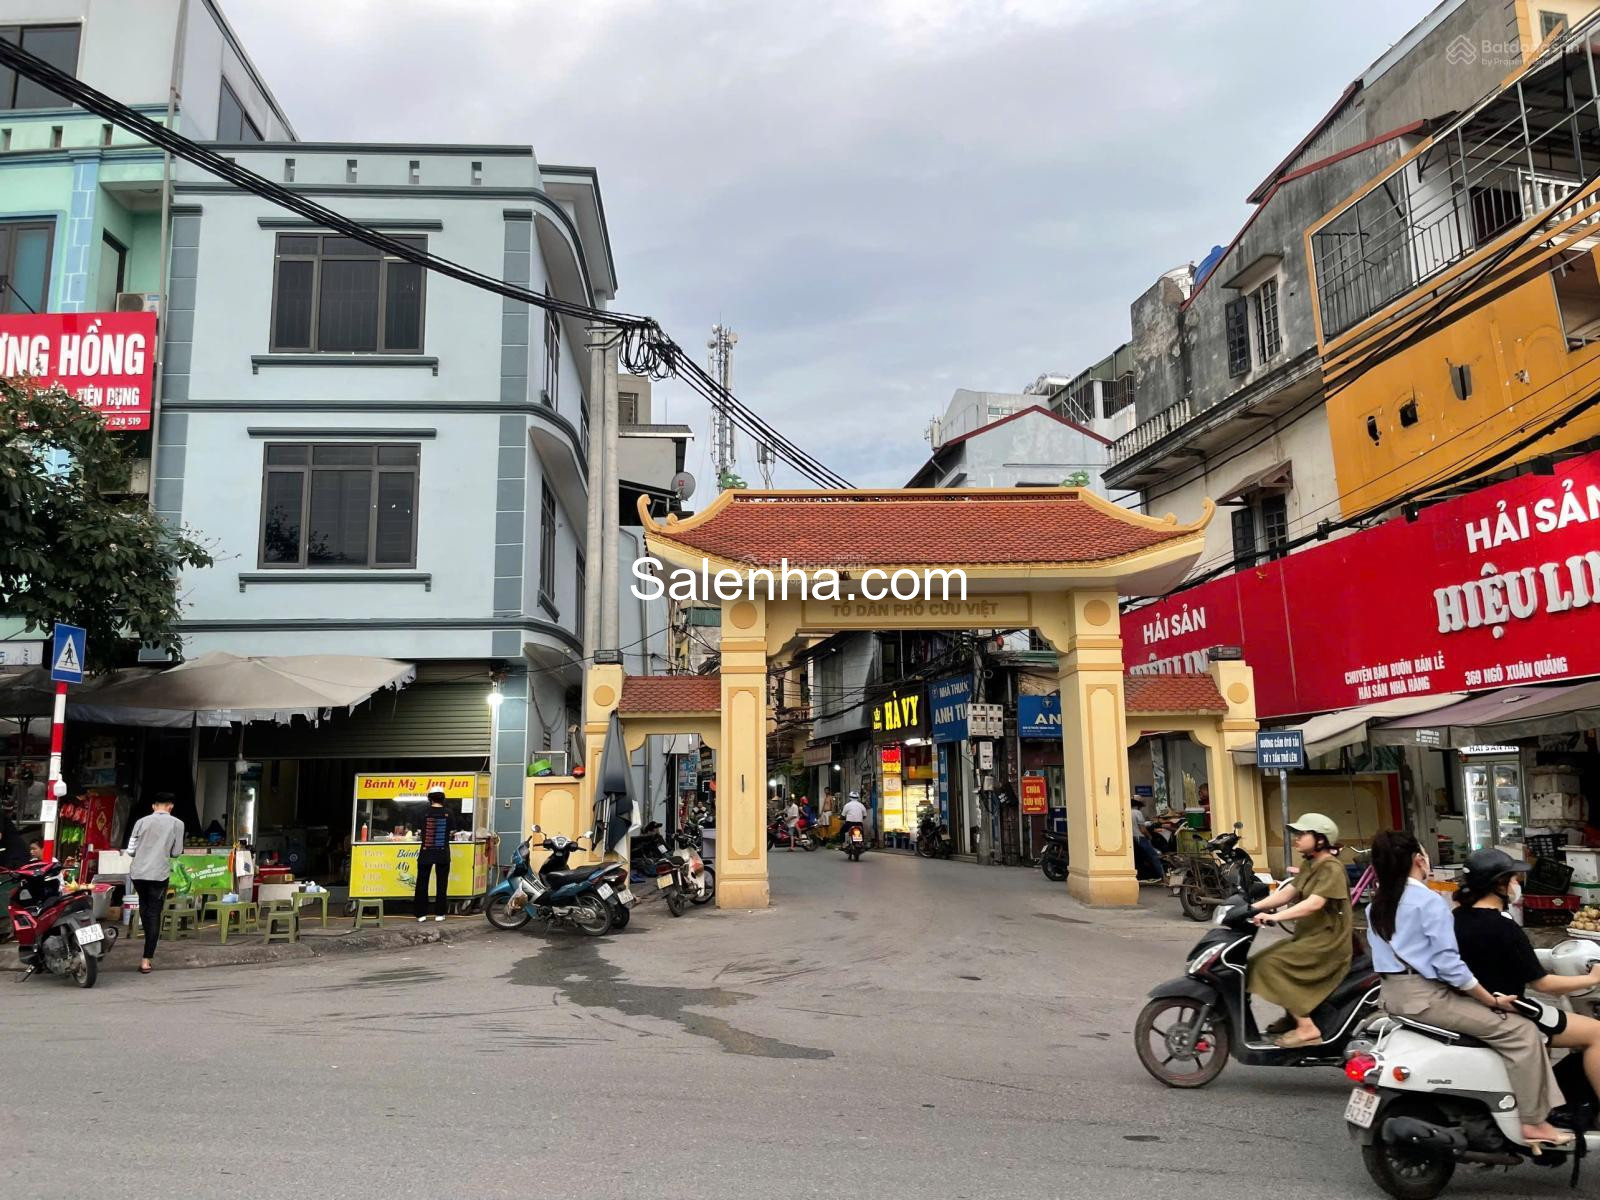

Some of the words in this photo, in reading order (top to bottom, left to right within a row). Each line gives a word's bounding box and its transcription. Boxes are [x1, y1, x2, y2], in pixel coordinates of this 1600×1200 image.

[59, 319, 146, 376] HỒNG
[1466, 500, 1530, 553] HẢI
[856, 601, 889, 617] DÂN
[965, 600, 999, 618] VIỆT
[1434, 562, 1538, 639] HIỆU
[1143, 612, 1170, 645] HẢI
[1171, 603, 1207, 636] SẢN
[1464, 669, 1481, 686] 369
[1483, 663, 1503, 684] NGÔ
[1505, 660, 1534, 681] XUÂN
[1533, 653, 1568, 678] QUẢNG
[935, 705, 954, 725] ANH
[1034, 713, 1062, 725] AN
[364, 779, 395, 789] Bánh
[448, 779, 469, 790] Jun
